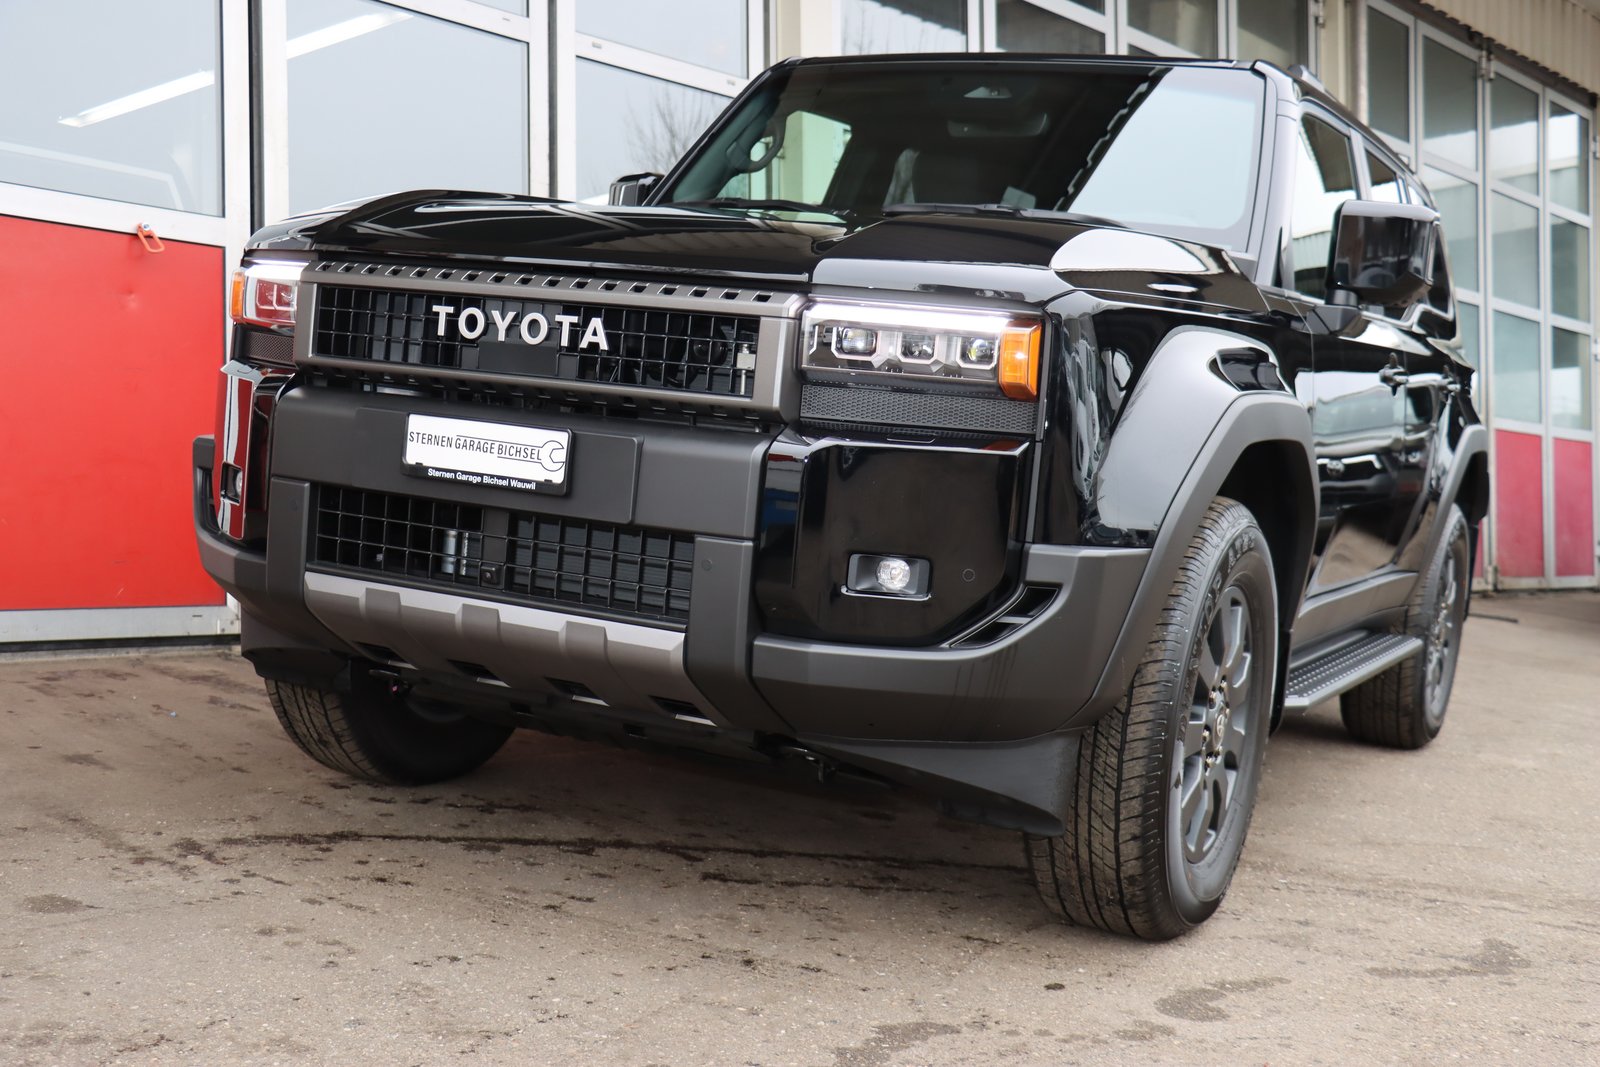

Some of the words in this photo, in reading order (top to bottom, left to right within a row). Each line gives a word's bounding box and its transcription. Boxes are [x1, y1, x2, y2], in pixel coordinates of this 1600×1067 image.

[432, 305, 608, 351] TOYOTA
[408, 431, 453, 449] STERNEN
[454, 437, 495, 455] GARAGE
[497, 444, 542, 461] BICHSEL
[427, 468, 455, 479] Sternen
[456, 472, 482, 484] Garage
[482, 475, 509, 487] Bichsel
[510, 480, 536, 490] Wauwil
